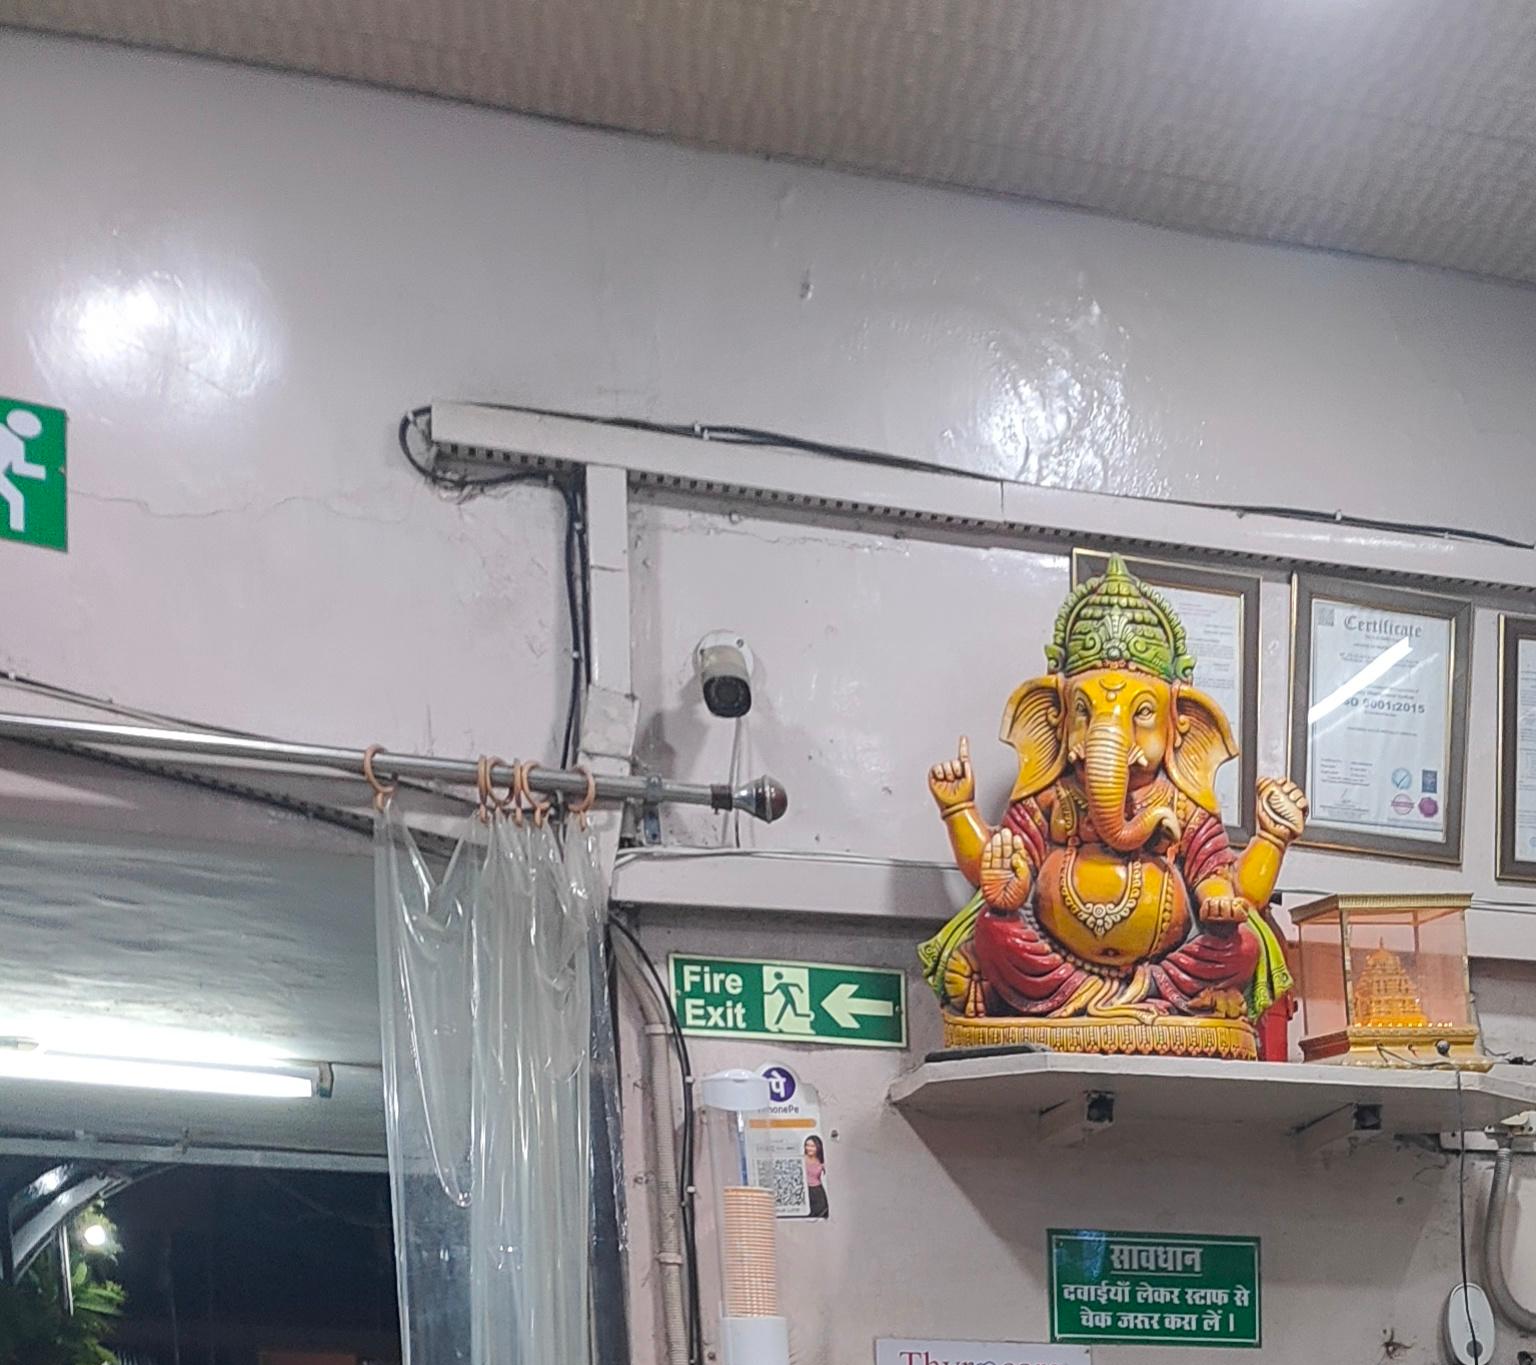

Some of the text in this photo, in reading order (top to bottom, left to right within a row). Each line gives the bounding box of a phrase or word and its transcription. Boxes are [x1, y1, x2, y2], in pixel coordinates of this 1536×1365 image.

[682, 964, 744, 995] Fire
[684, 998, 747, 1029] Exit
[1109, 1244, 1204, 1273] सावधान
[1061, 1280, 1250, 1307] दवाईयाँ लेकर स्टाफ से
[1079, 1306, 1113, 1328] चेक
[1164, 1313, 1198, 1331] करा
[1202, 1310, 1222, 1332] लें
